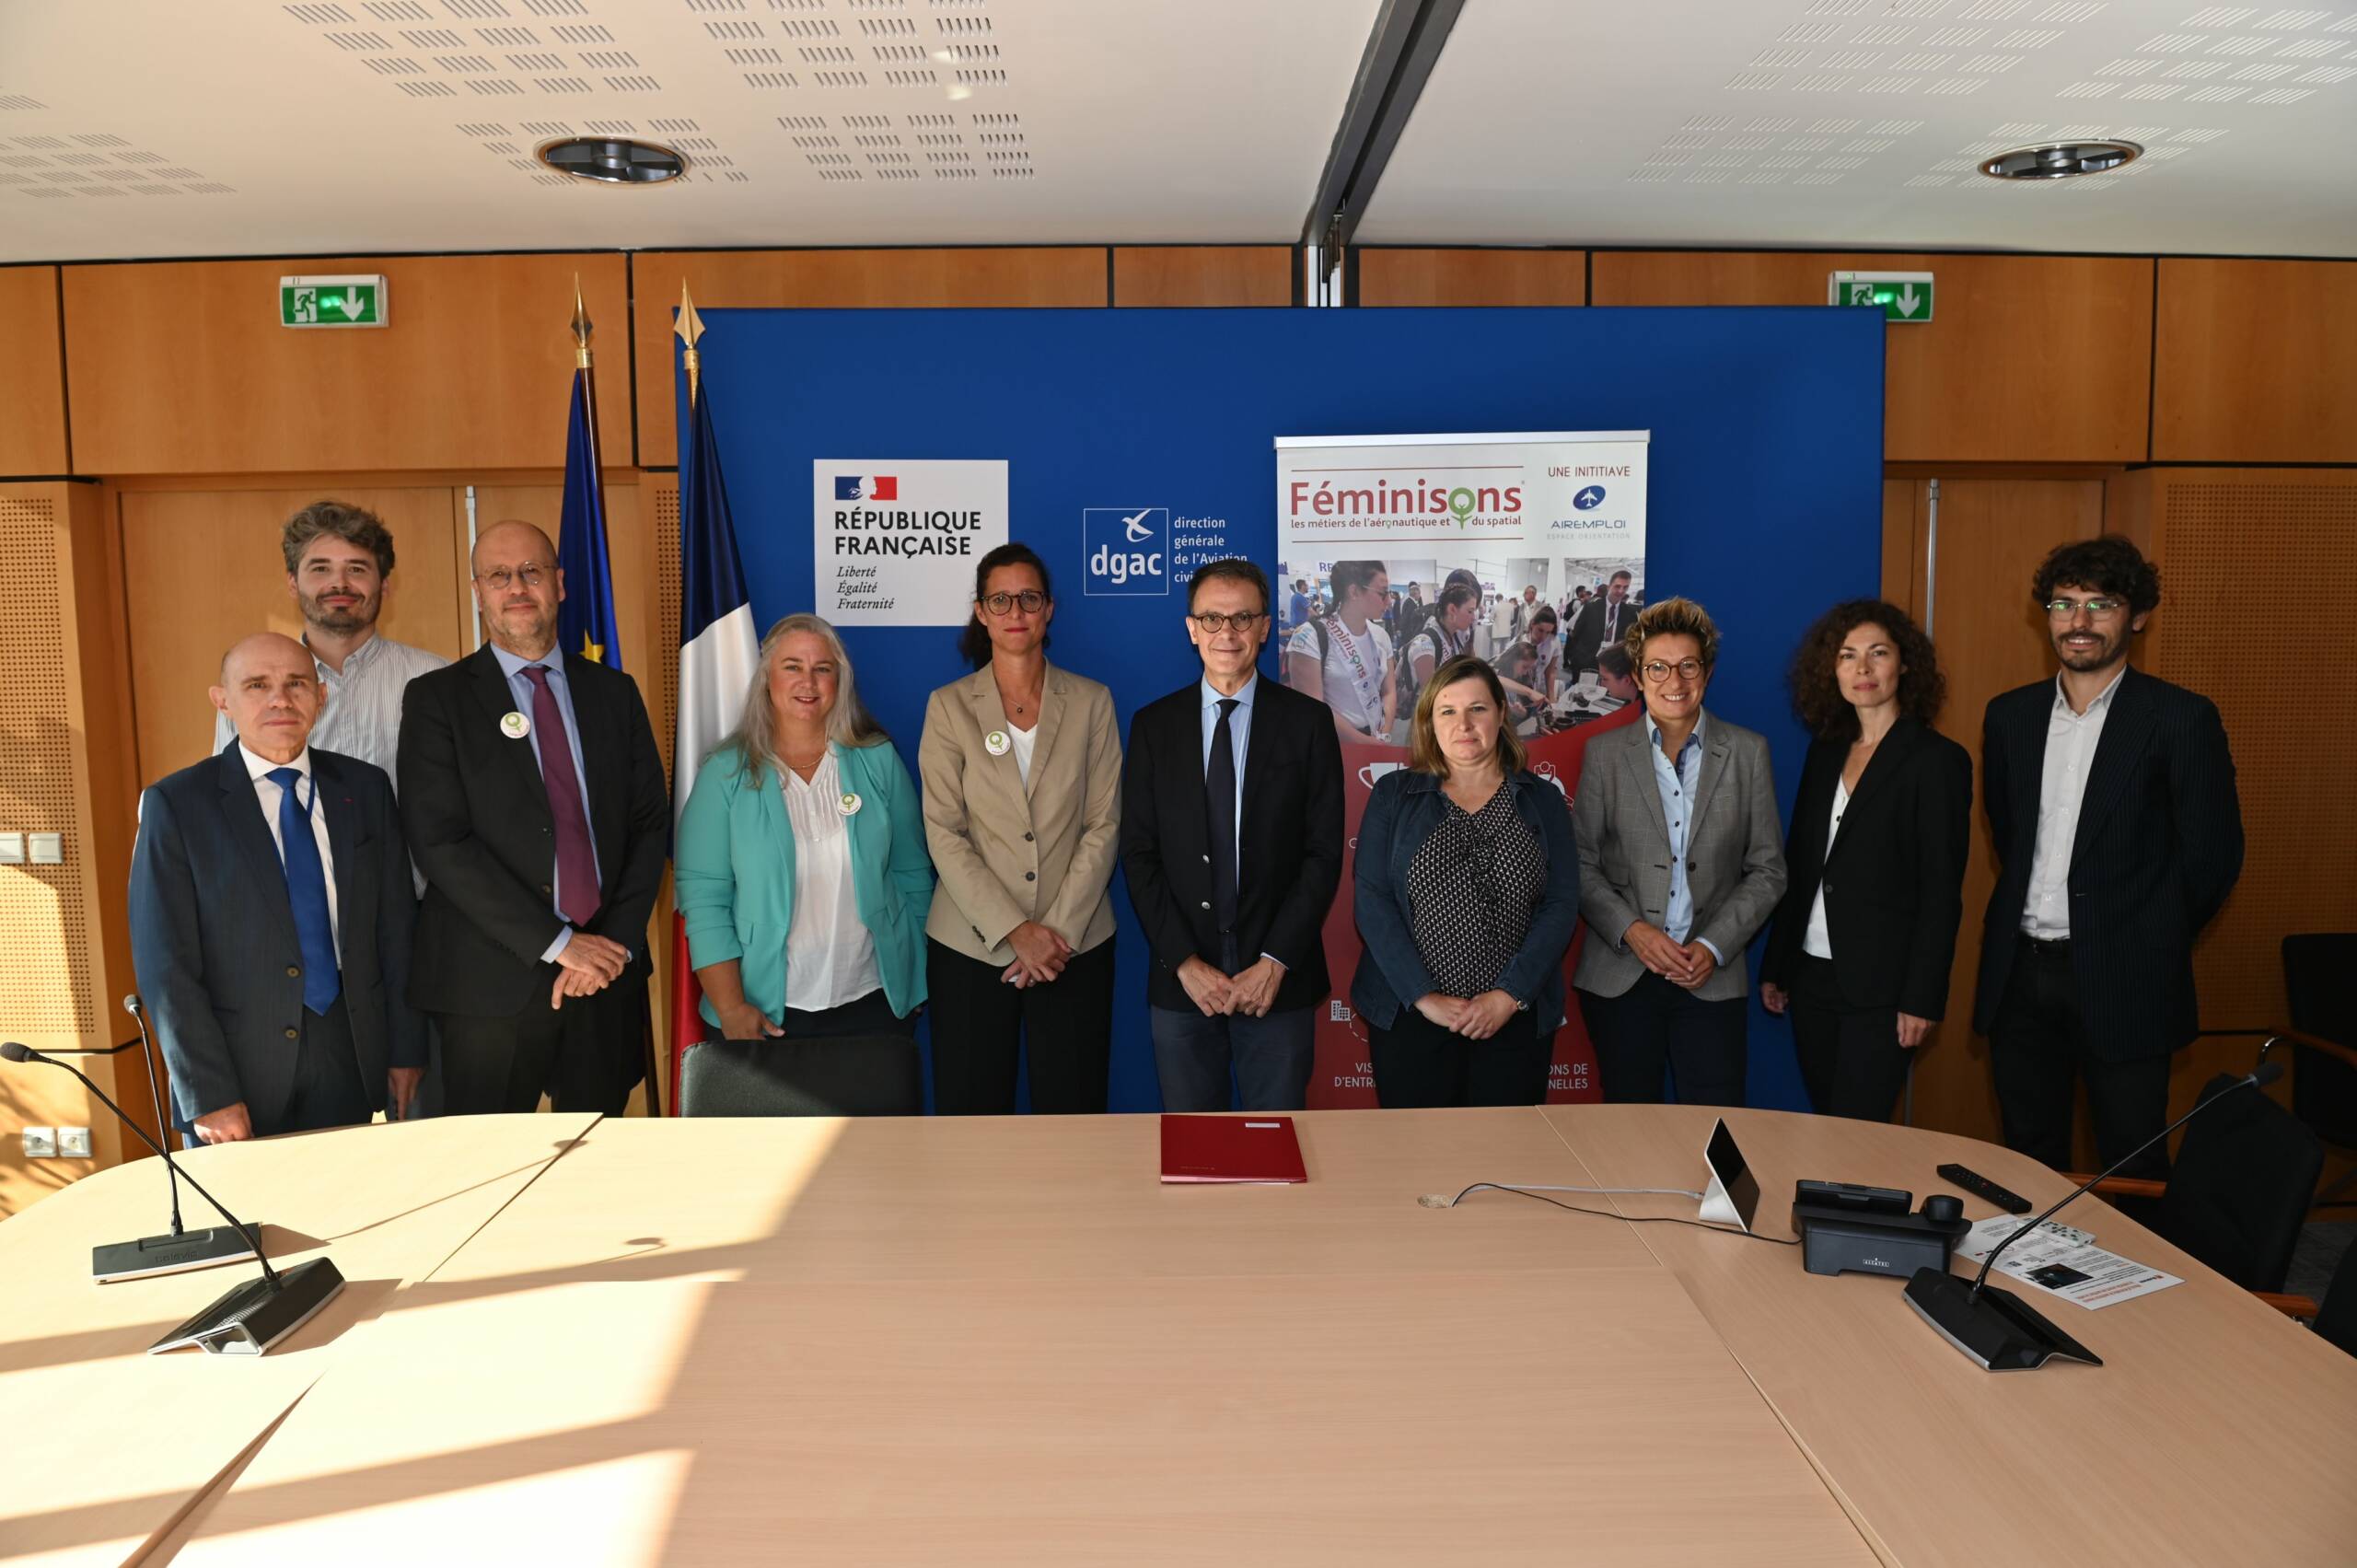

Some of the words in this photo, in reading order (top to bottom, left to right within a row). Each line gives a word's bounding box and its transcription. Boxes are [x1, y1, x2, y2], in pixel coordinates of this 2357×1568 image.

[1549, 466, 1571, 478] UNE
[1575, 465, 1631, 477] INITITIAVE
[1291, 478, 1522, 522] Féminisons
[834, 506, 981, 534] RÉPUBLIQUE
[1174, 517, 1225, 528] direction
[1291, 519, 1306, 528] les
[1307, 518, 1346, 528] métiers
[1349, 517, 1361, 528] de
[1440, 517, 1450, 527] et
[1471, 517, 1484, 526] du
[1487, 515, 1522, 528] spatial
[1550, 519, 1626, 529] AIREMPLOI
[834, 536, 971, 559] FRANÇAISE
[1174, 534, 1225, 550] générale
[1090, 544, 1162, 584] dgac
[1174, 552, 1189, 564] de
[837, 565, 877, 577] Liberté
[1174, 571, 1194, 582] civi
[837, 579, 877, 596] Égalité
[837, 598, 895, 610] Fraternité
[1573, 1063, 1588, 1074] DE
[1334, 1076, 1376, 1088] D'ENTR
